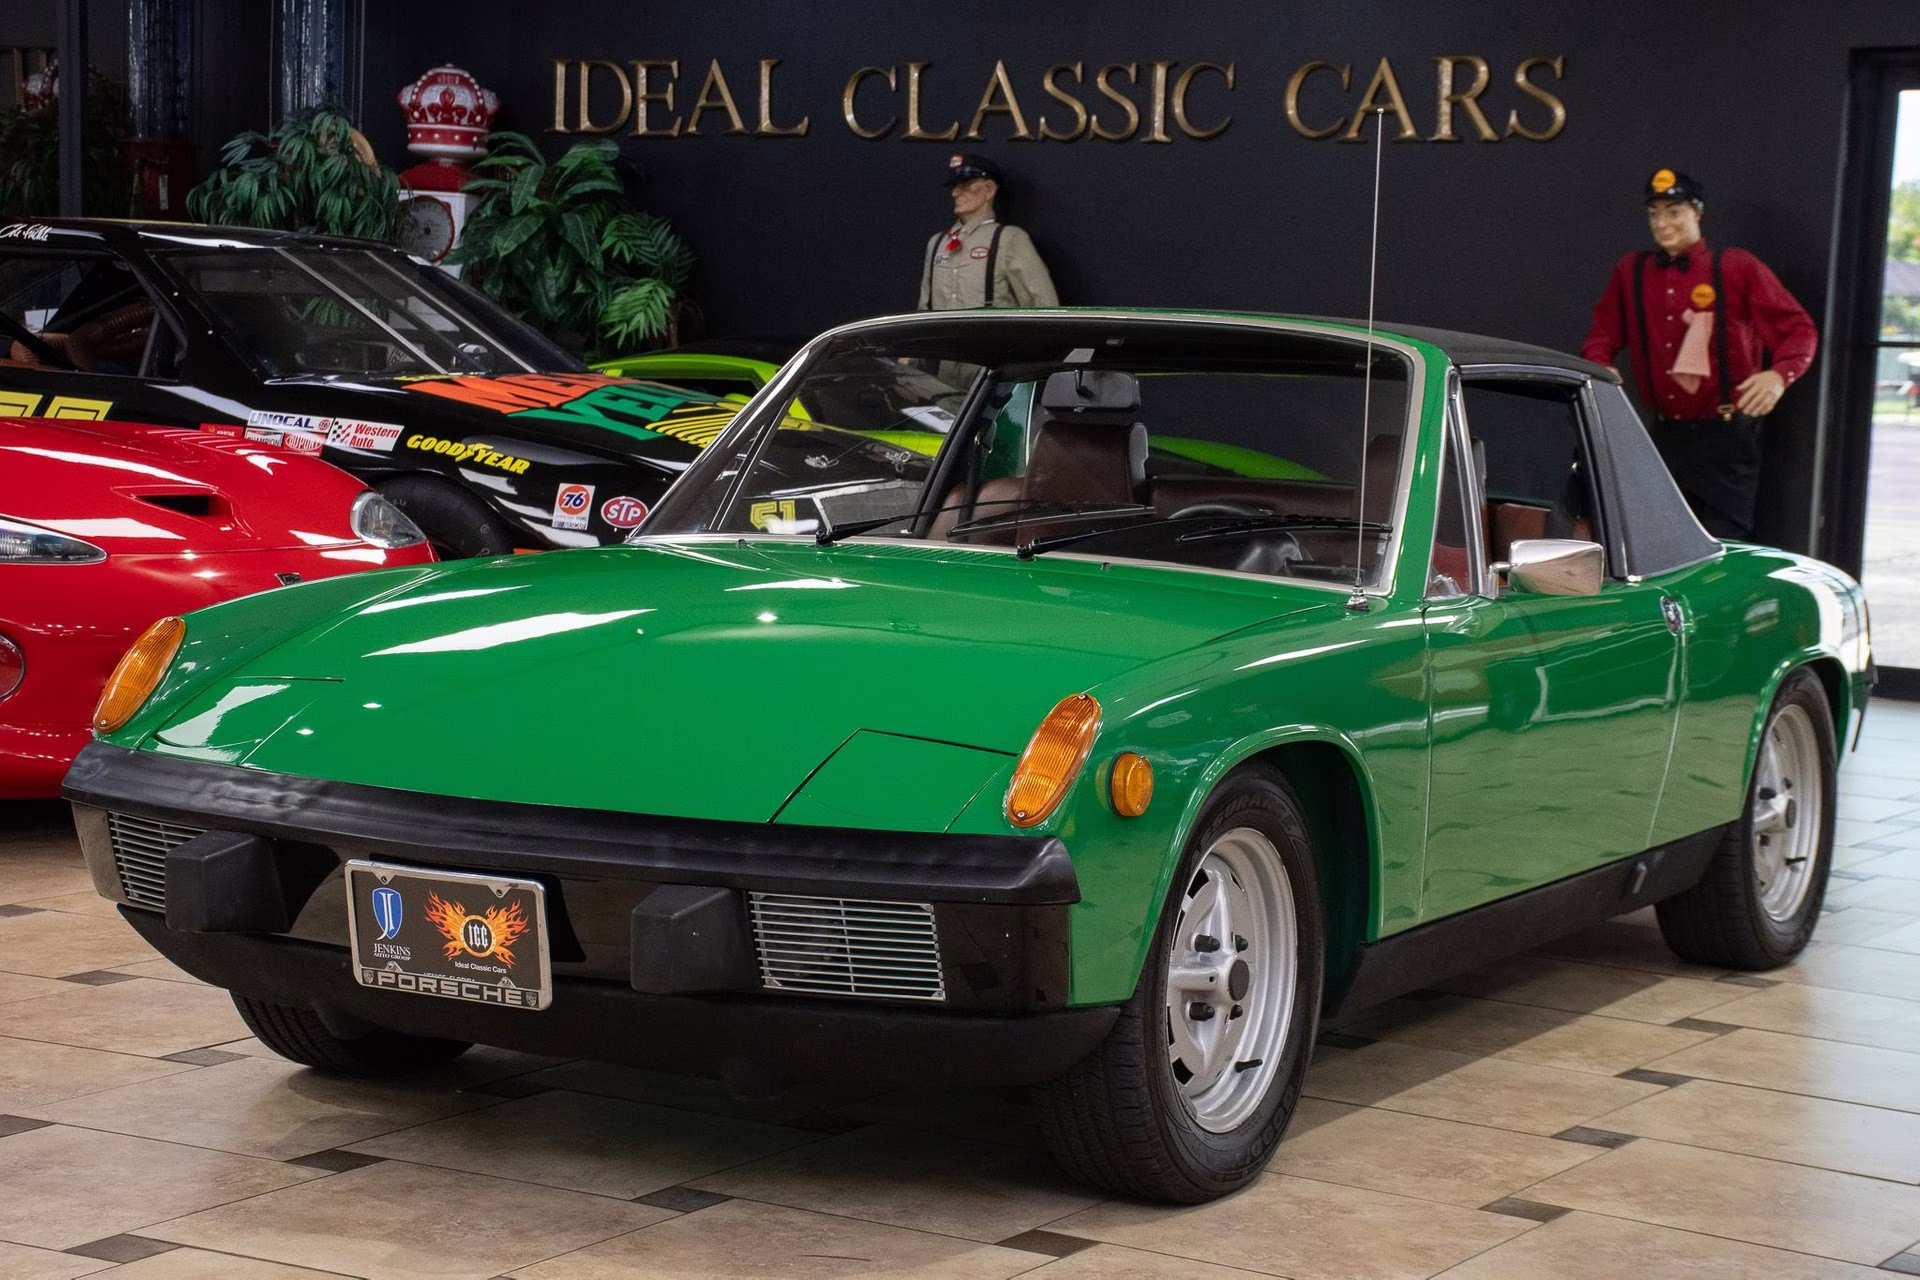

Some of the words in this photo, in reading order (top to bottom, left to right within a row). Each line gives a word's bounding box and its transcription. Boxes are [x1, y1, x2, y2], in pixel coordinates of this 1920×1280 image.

[544, 58, 809, 138] IDEAL
[843, 60, 1235, 142] CLASSIC
[1284, 55, 1567, 143] CARS
[249, 411, 315, 429] UNOCAL
[354, 423, 401, 438] Western
[407, 435, 531, 475] GOODYEAR
[562, 492, 587, 508] 76
[607, 500, 642, 521] STP
[468, 922, 488, 949] ICC
[373, 943, 411, 957] JENKINS
[454, 961, 470, 969] Ideal
[470, 963, 492, 972] Classic
[492, 965, 507, 974] Cars
[377, 971, 522, 1005] PORSCHE
